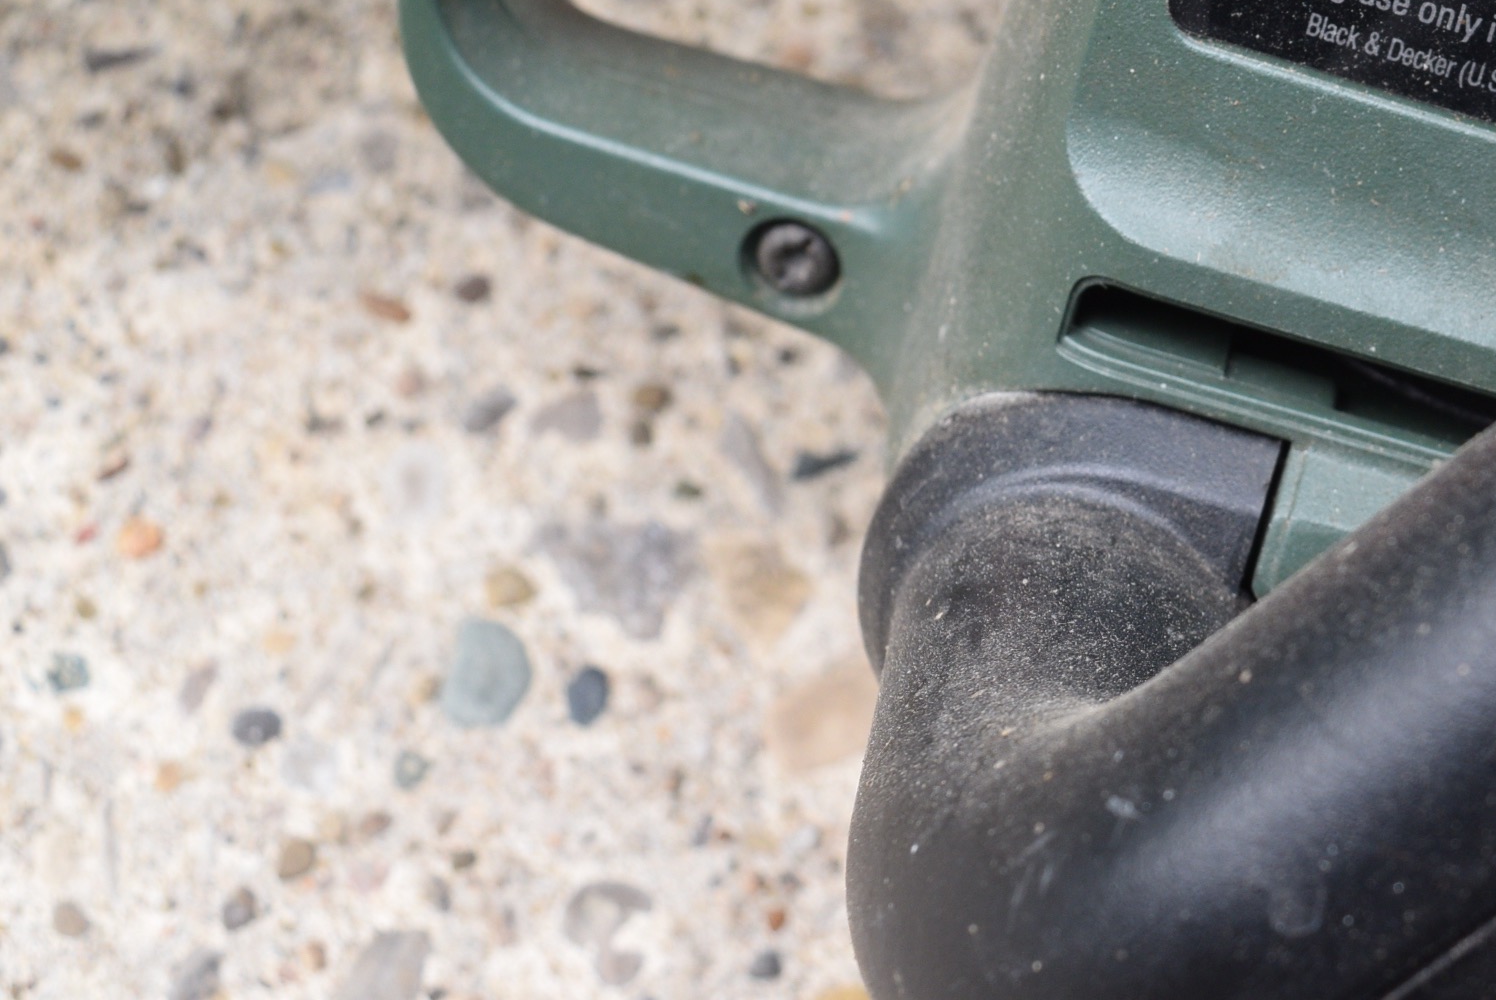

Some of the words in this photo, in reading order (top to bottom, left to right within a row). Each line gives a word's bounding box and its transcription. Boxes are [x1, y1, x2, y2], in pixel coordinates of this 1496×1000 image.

[1306, 12, 1359, 46] Black
[1365, 32, 1380, 54] &
[1386, 37, 1459, 79] Decker
[1418, 1, 1482, 43] only
